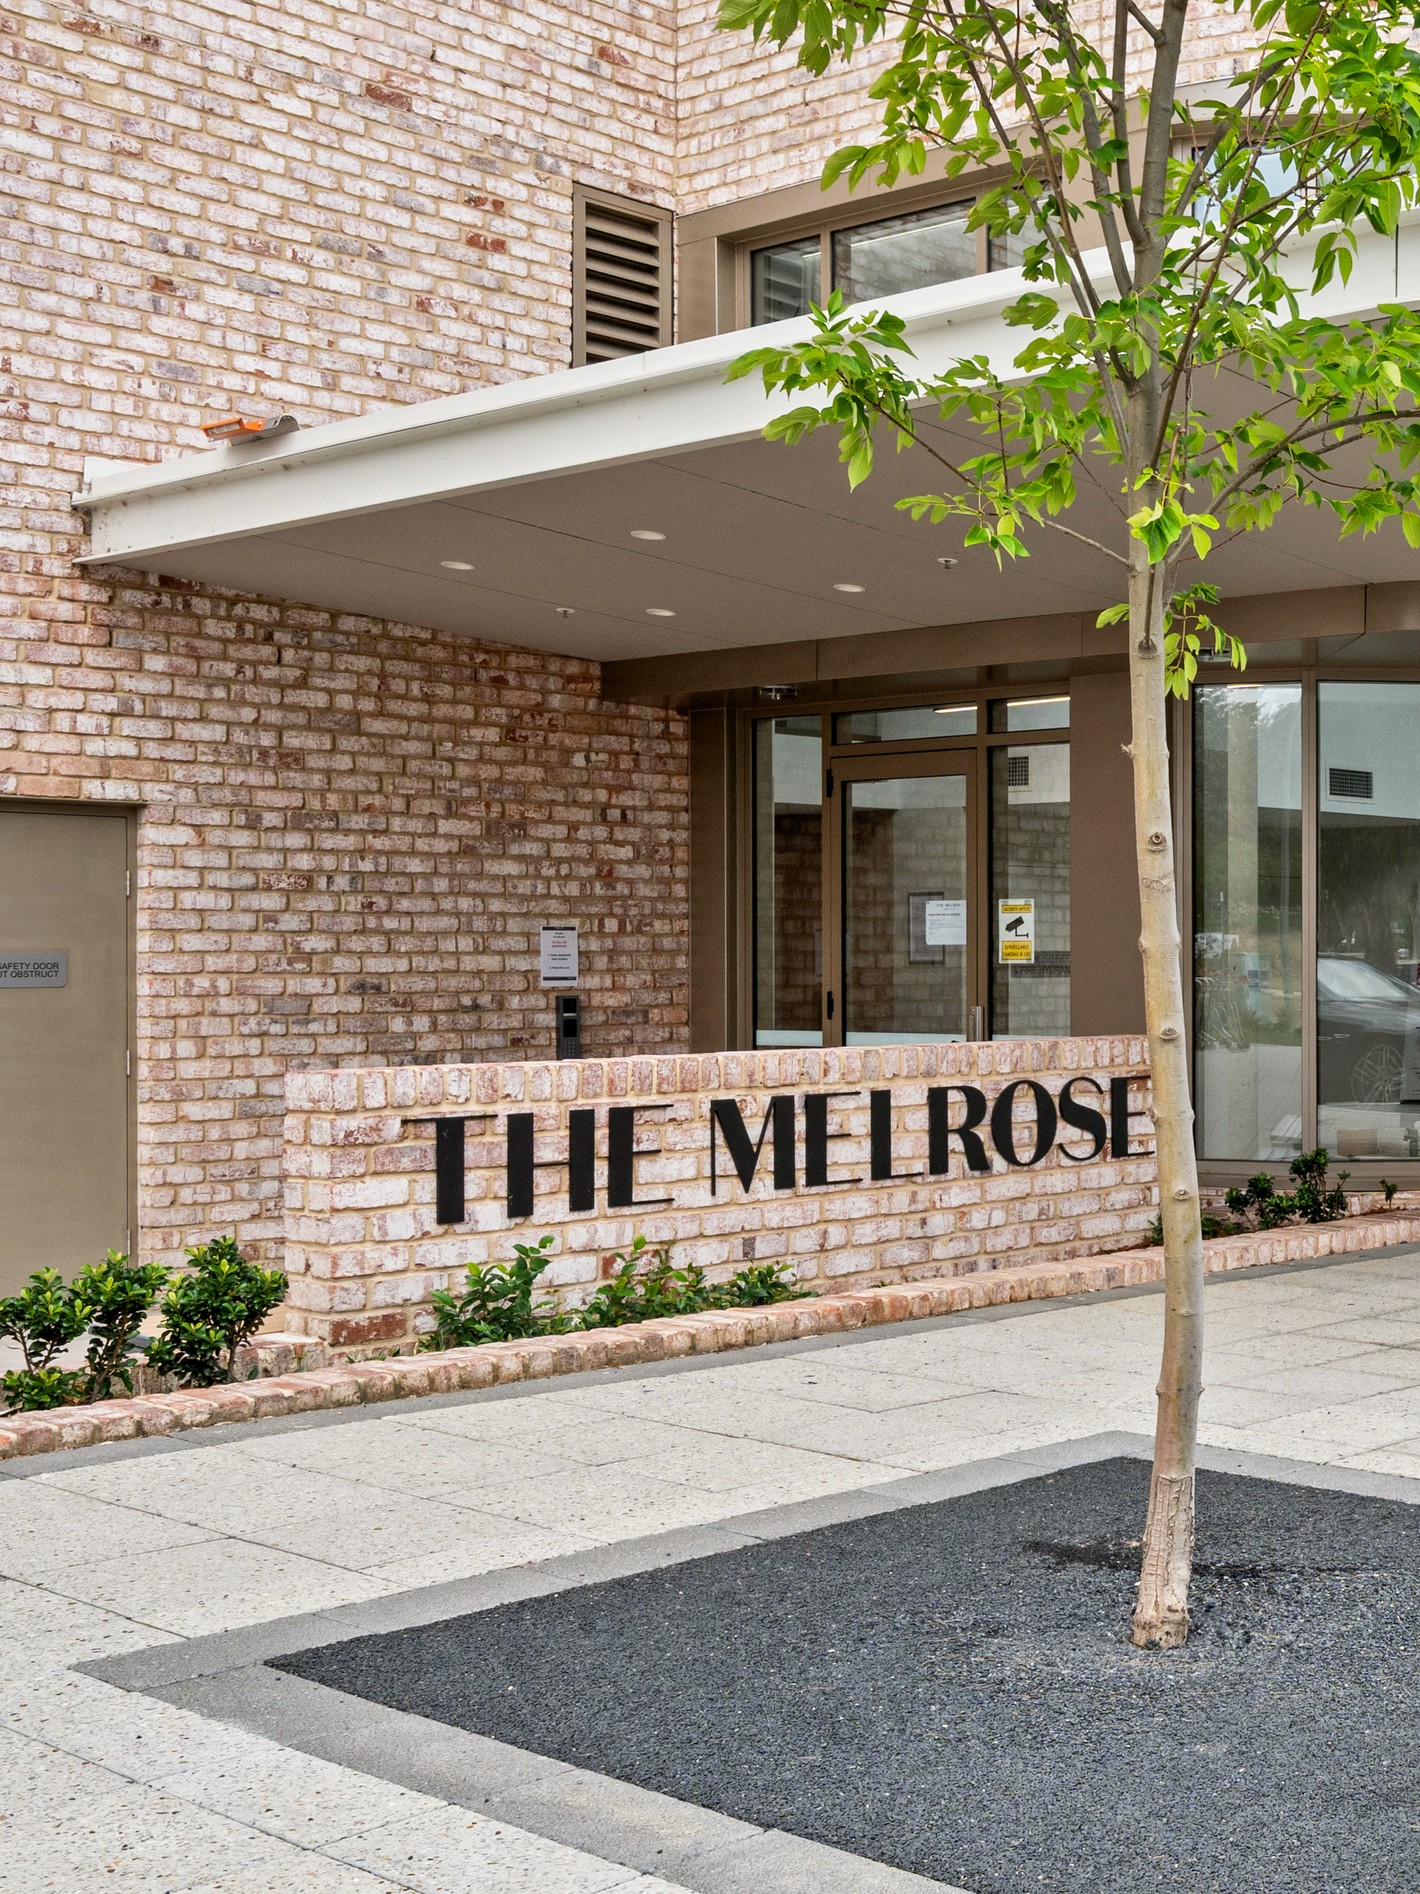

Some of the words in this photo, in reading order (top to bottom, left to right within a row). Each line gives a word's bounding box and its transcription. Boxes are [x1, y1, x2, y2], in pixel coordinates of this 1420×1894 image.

[0, 962, 31, 970] AFETY
[33, 962, 60, 970] DOOR
[10, 970, 59, 978] OBSTRUCT
[401, 1104, 675, 1225] THE
[710, 1075, 1155, 1196] MELROSE
